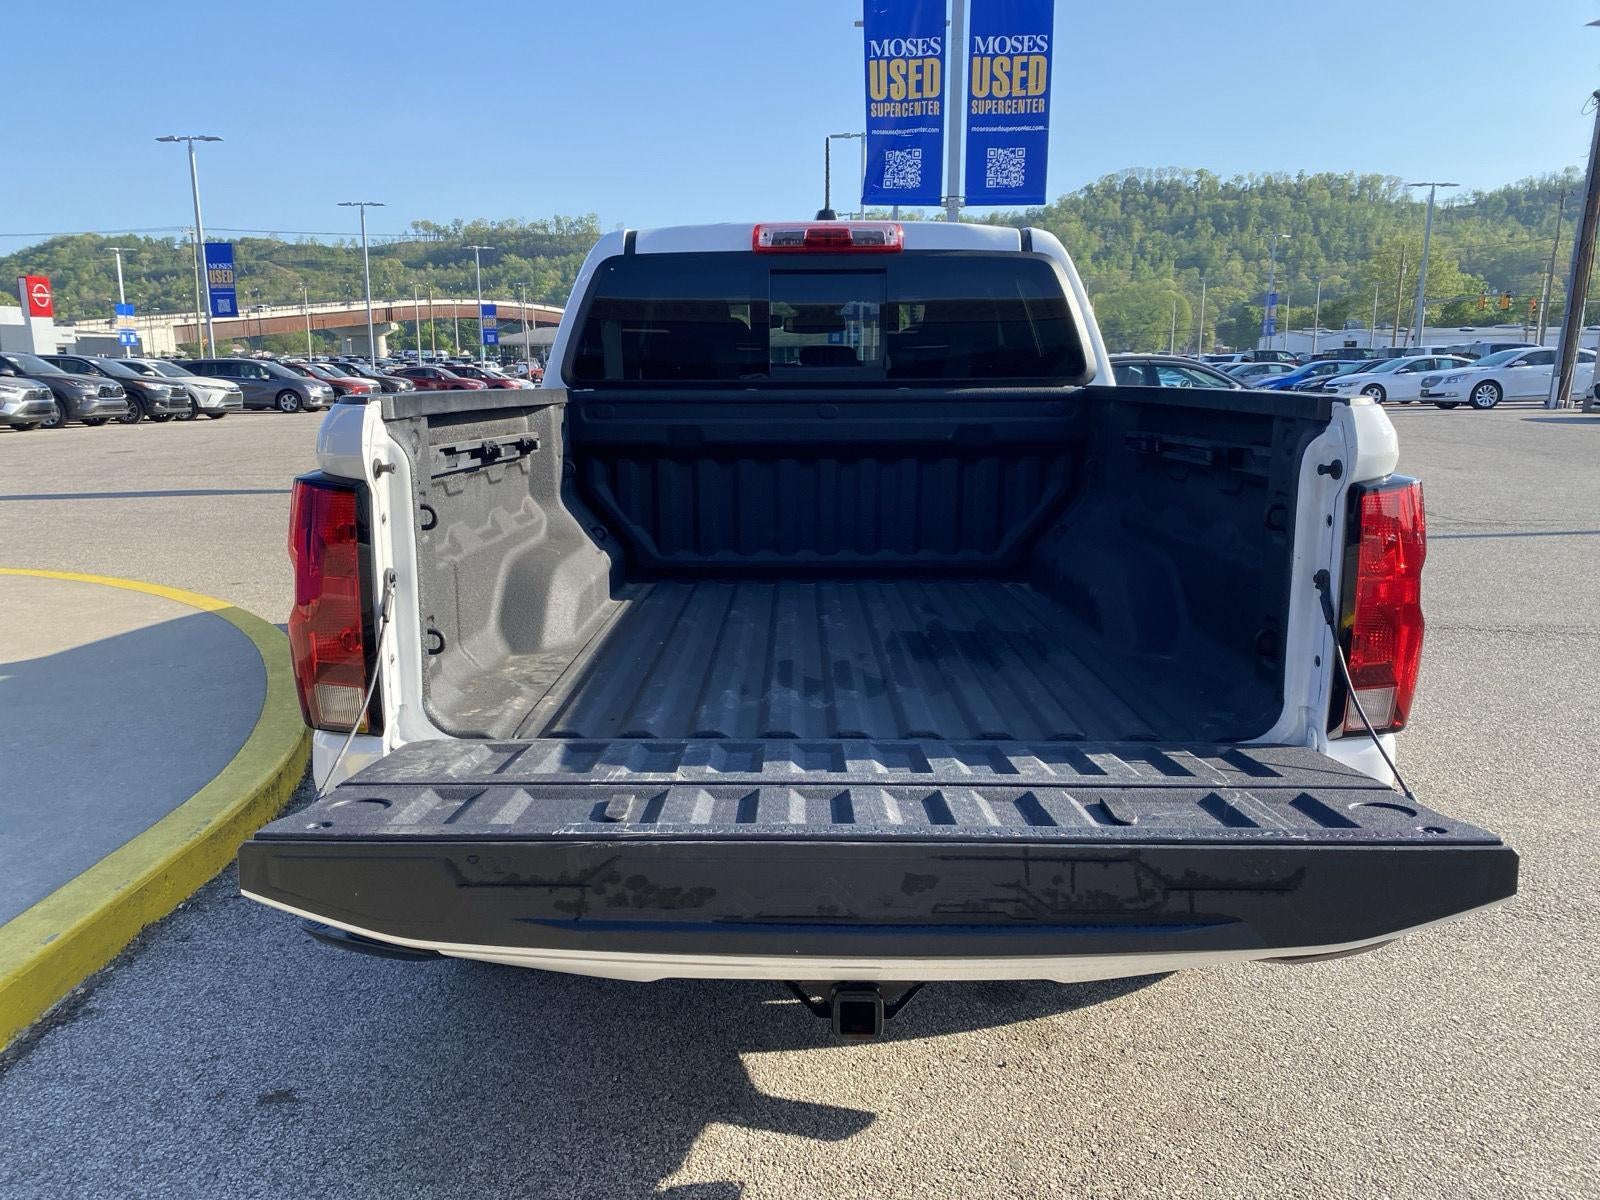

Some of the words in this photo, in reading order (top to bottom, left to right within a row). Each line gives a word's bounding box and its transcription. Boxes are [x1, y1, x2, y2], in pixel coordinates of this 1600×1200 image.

[869, 37, 941, 58] MOSES
[974, 35, 1048, 54] MOSES
[869, 58, 941, 100] USED
[972, 55, 1047, 98] USED
[870, 101, 940, 118] SUPERCENTER
[971, 98, 1045, 115] SUPERCENTER
[209, 270, 234, 283] USED
